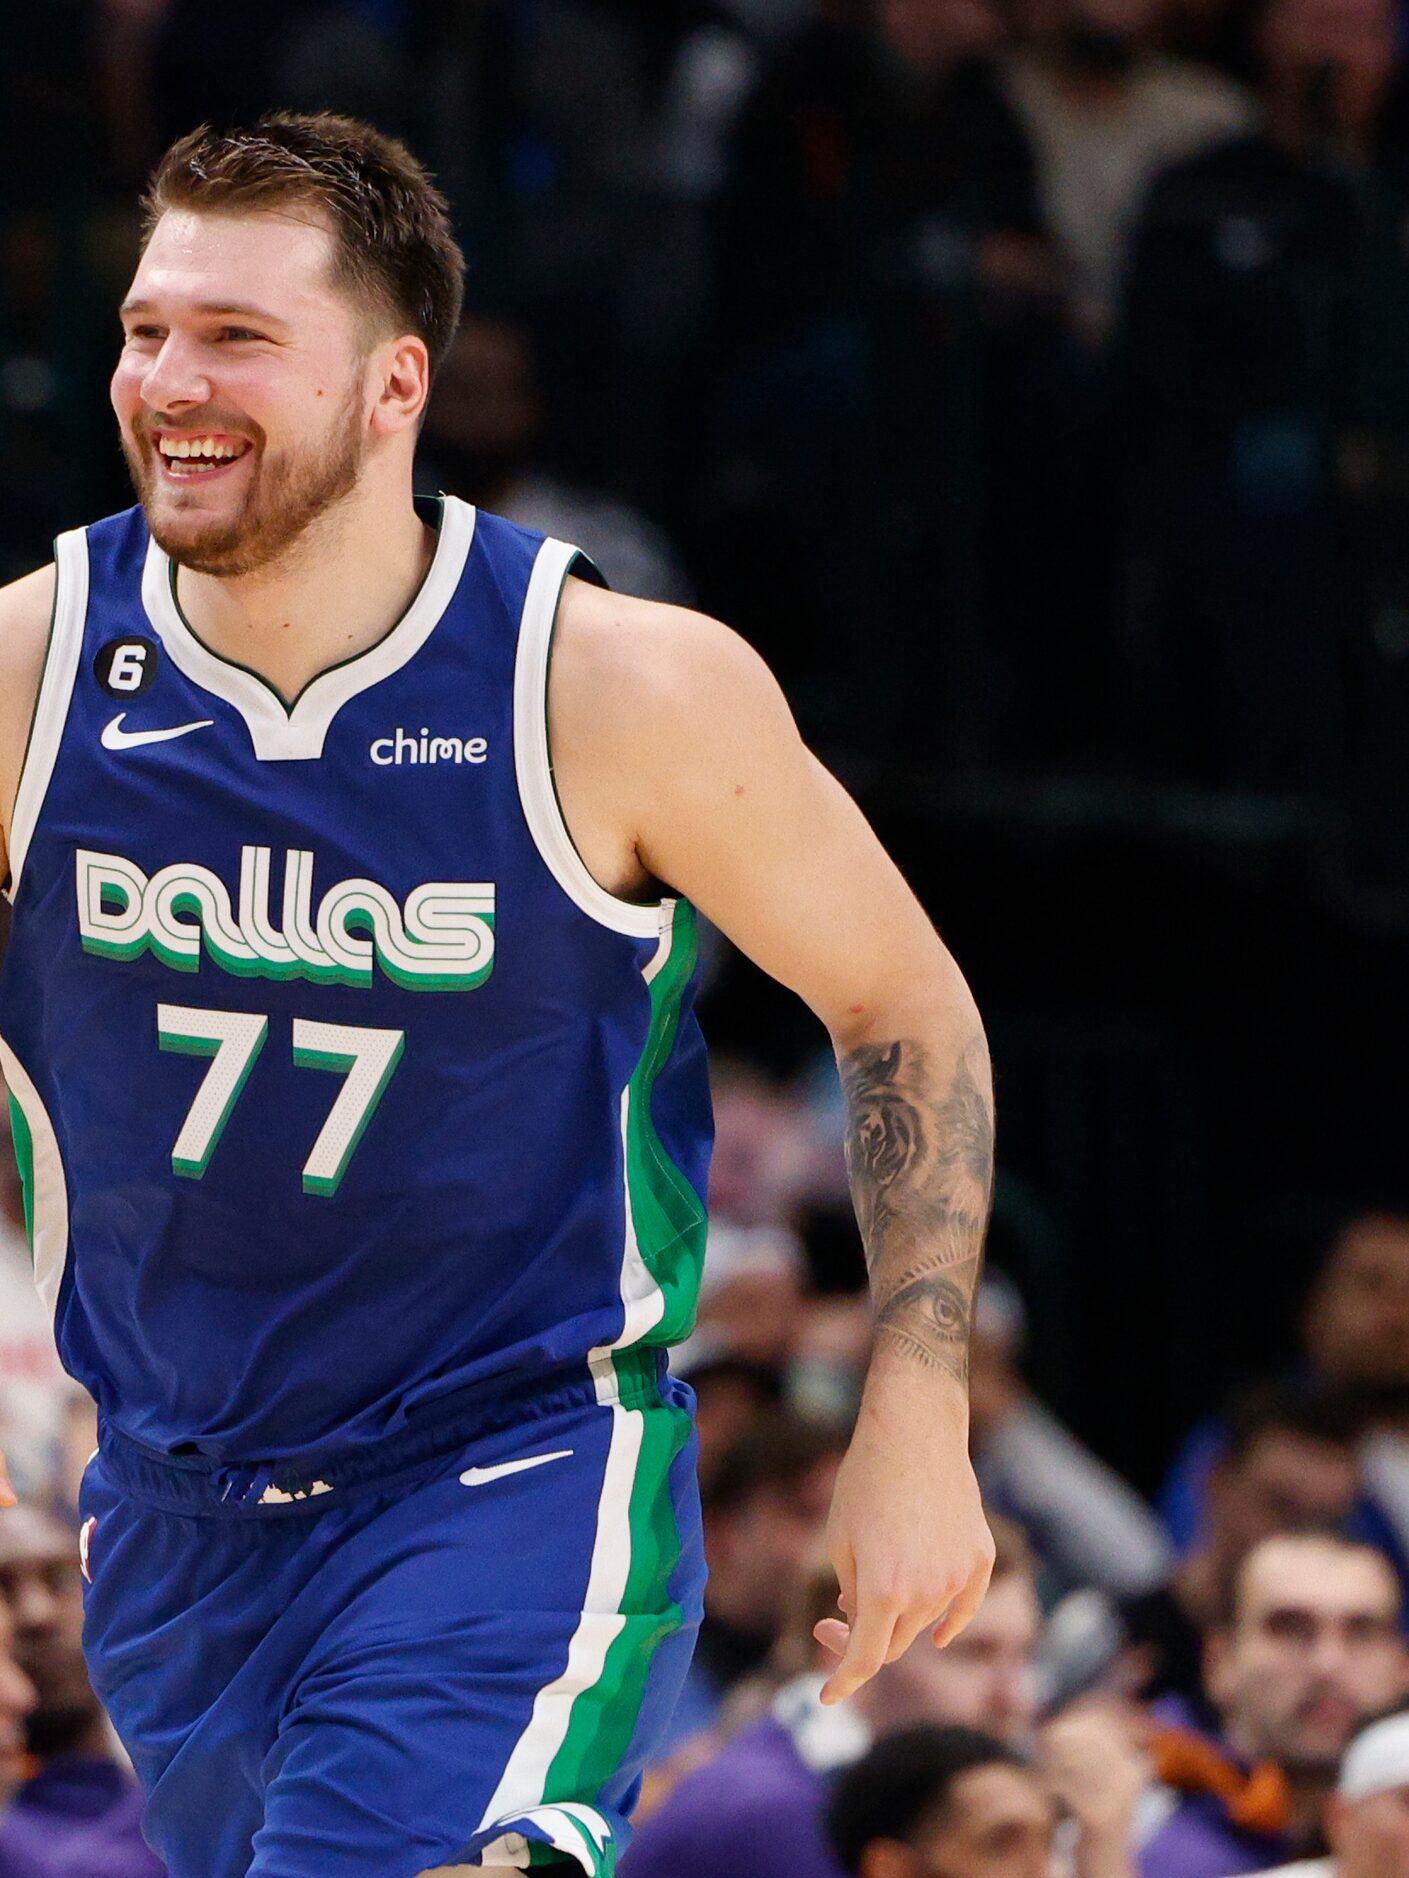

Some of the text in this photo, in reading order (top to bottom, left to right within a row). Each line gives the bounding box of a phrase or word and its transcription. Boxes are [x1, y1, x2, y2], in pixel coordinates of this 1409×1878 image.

[107, 644, 147, 691] 6
[369, 727, 488, 766] chime
[76, 845, 495, 992] Dallas
[157, 1003, 405, 1197] 77
